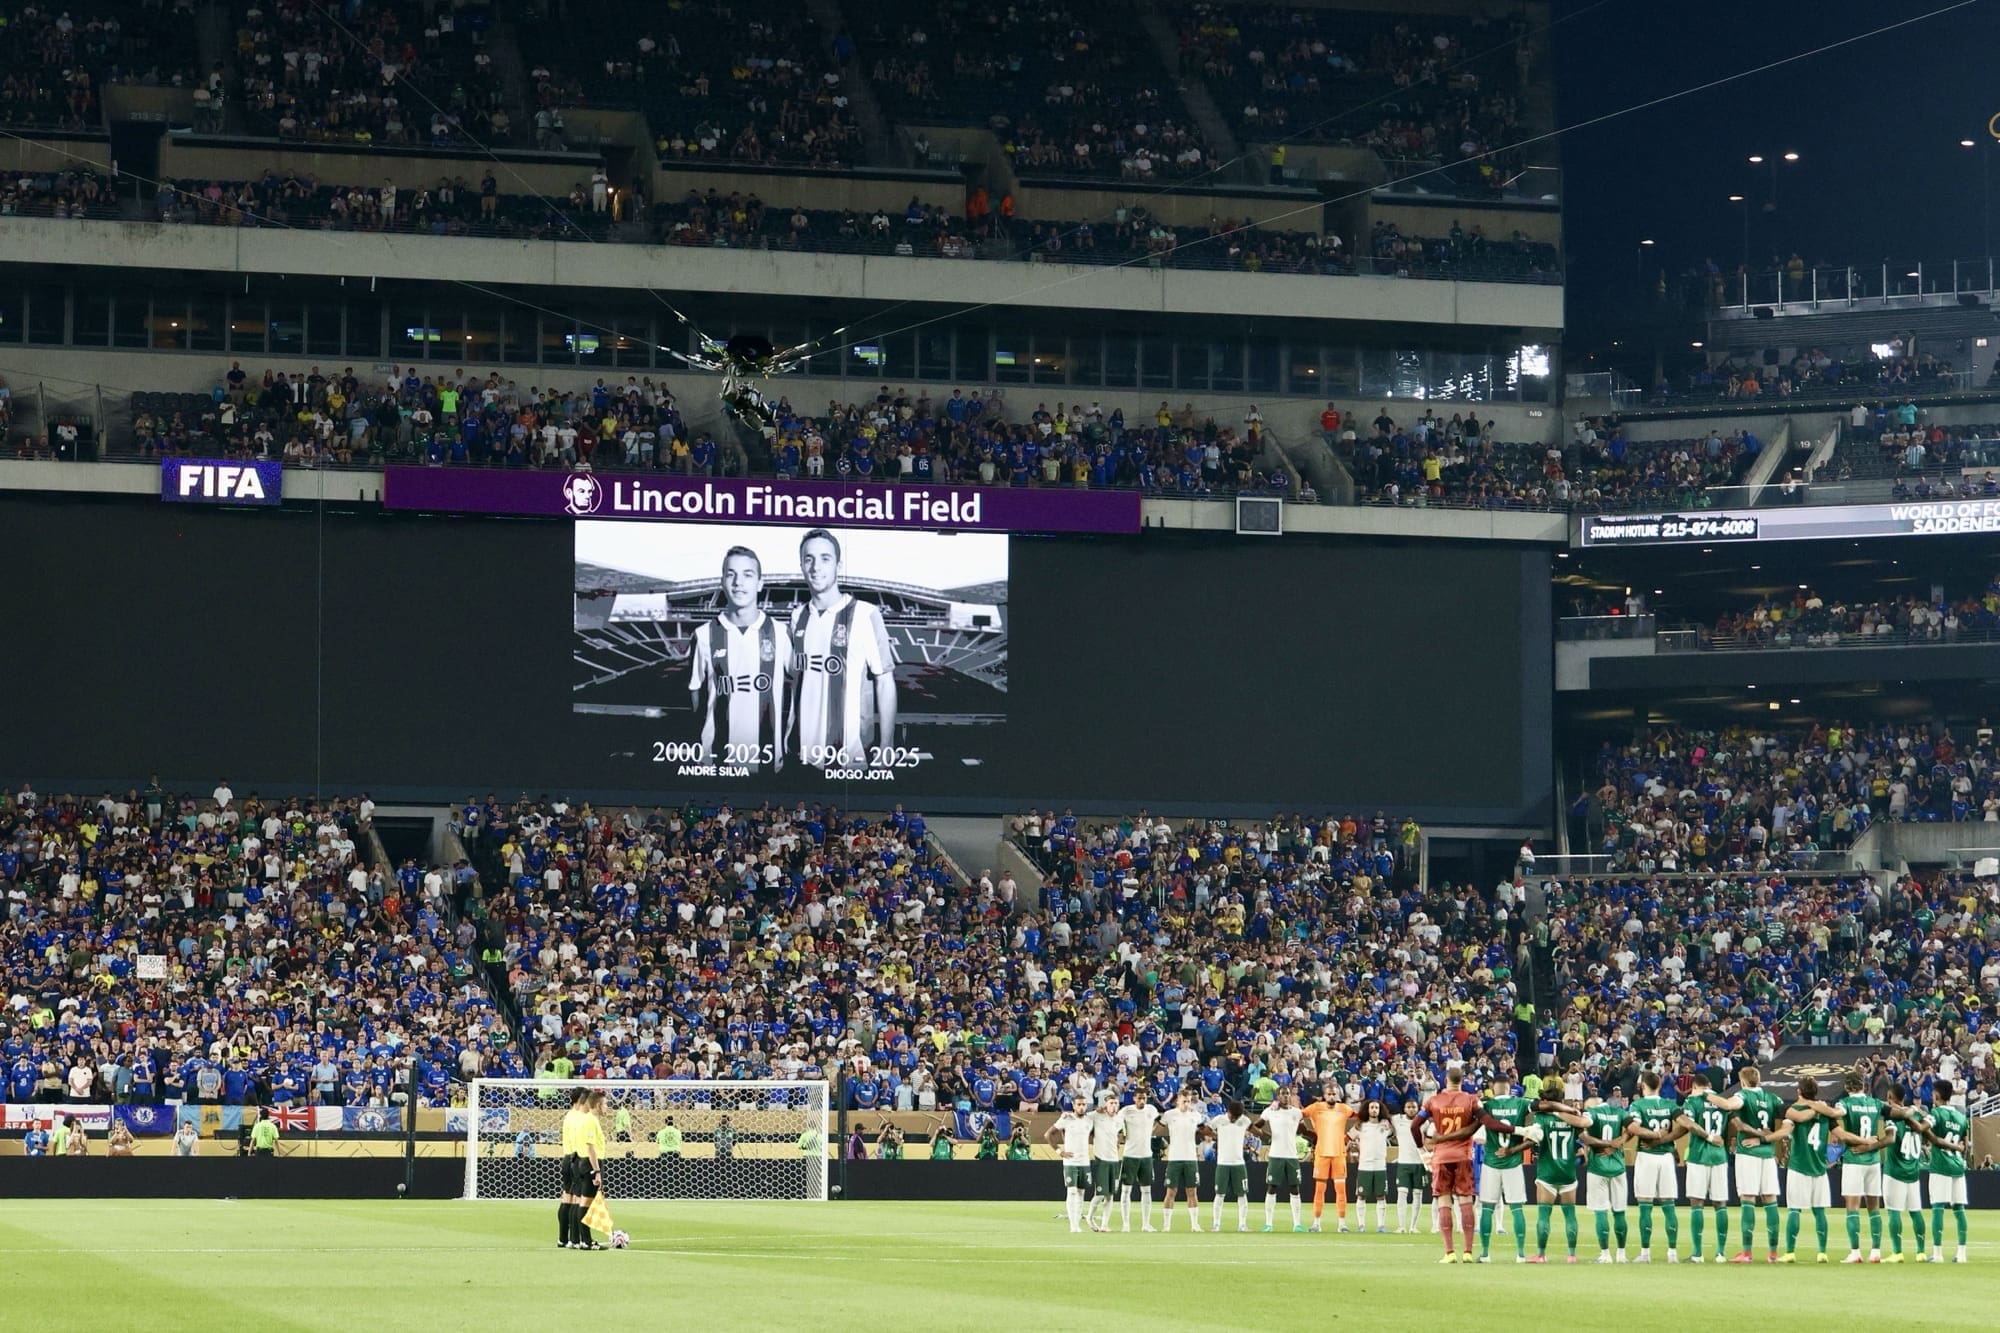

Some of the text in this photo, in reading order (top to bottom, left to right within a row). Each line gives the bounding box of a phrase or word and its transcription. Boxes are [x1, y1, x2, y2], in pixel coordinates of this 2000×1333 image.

[179, 465, 265, 498] FIFA
[613, 481, 981, 523] Lincoln Financial Field
[1890, 504, 1954, 520] WORLD
[1957, 503, 1981, 517] OF
[1590, 525, 1625, 538] STADIUM
[1625, 524, 1659, 537] HOTLINE
[652, 741, 703, 762] 2000
[723, 743, 773, 764] 2025
[800, 745, 850, 766] 1996
[869, 746, 920, 768] 2025
[718, 766, 750, 777] SILVA
[825, 769, 895, 780] DIOGO JOTA
[1702, 1110, 1723, 1138] 13
[1757, 1110, 1769, 1132] 3
[1860, 1115, 1872, 1138] 8
[1549, 1131, 1572, 1160] 17
[1807, 1122, 1821, 1151] 4
[1901, 1131, 1922, 1160] 40
